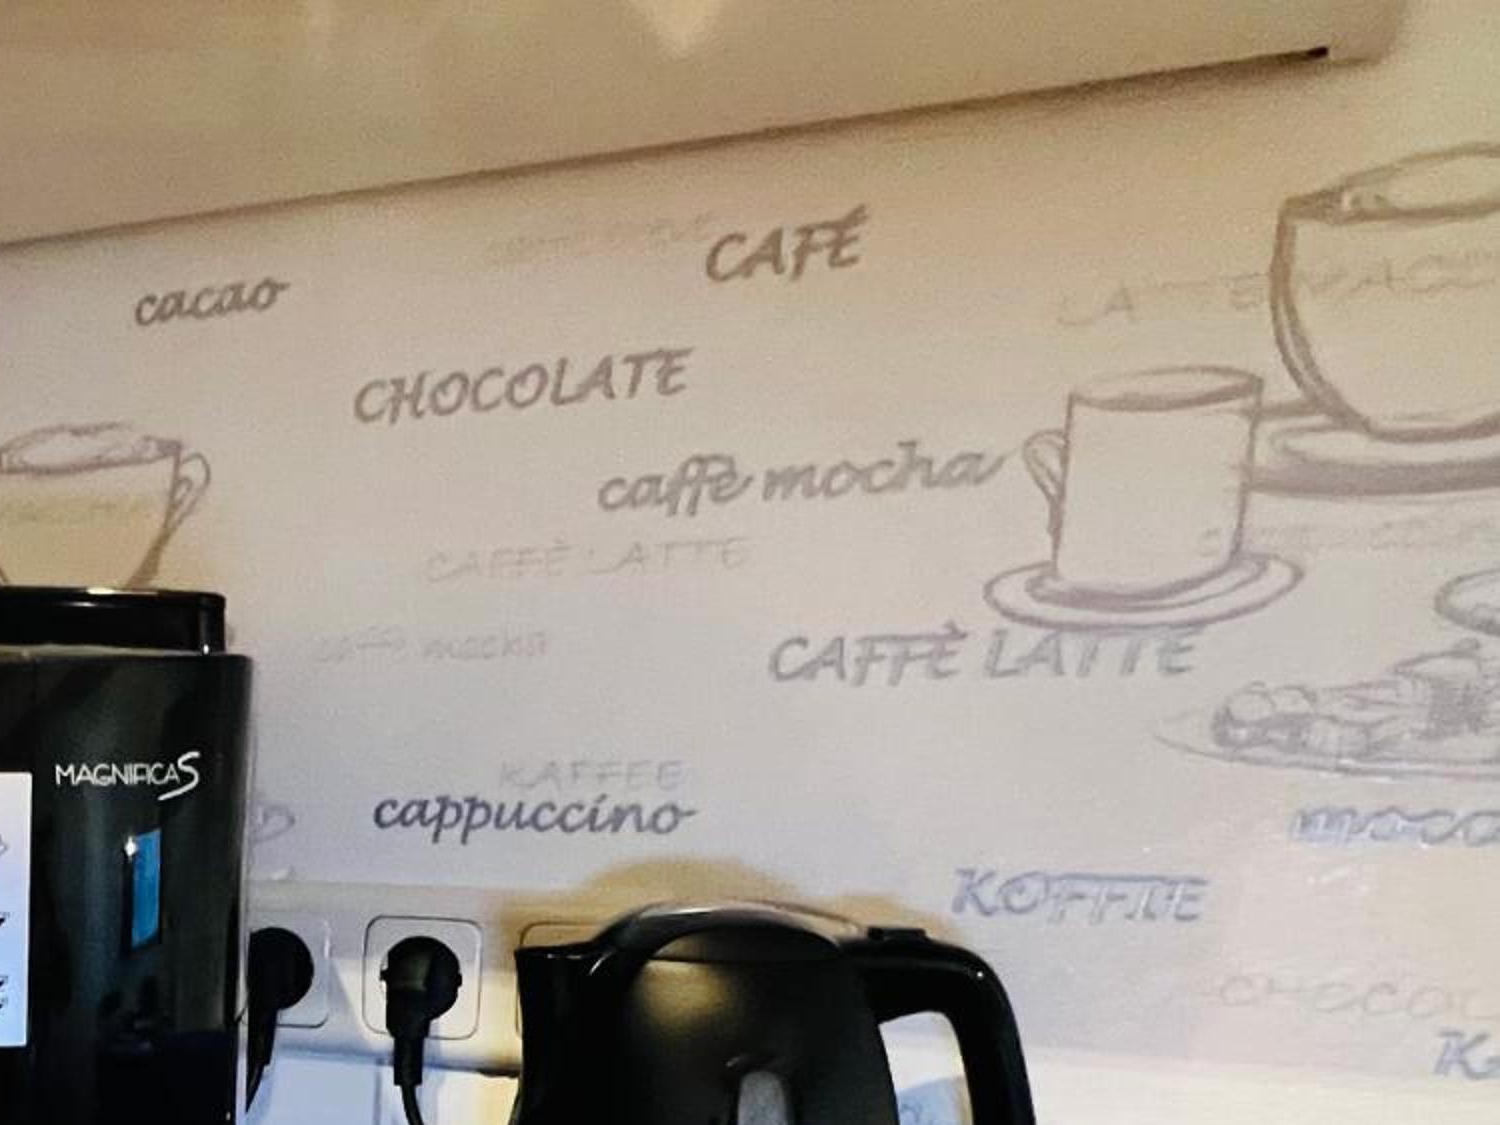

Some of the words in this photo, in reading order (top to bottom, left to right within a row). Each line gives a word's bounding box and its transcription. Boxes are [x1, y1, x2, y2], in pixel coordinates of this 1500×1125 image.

[134, 277, 291, 326] cacao
[354, 348, 693, 424] CHOCOLATE
[762, 440, 1004, 502] mocha
[768, 620, 968, 687] CAFFÈ
[983, 626, 1205, 678] LATTE
[55, 763, 180, 786] MAGNIFICA
[373, 793, 697, 846] cappuccino
